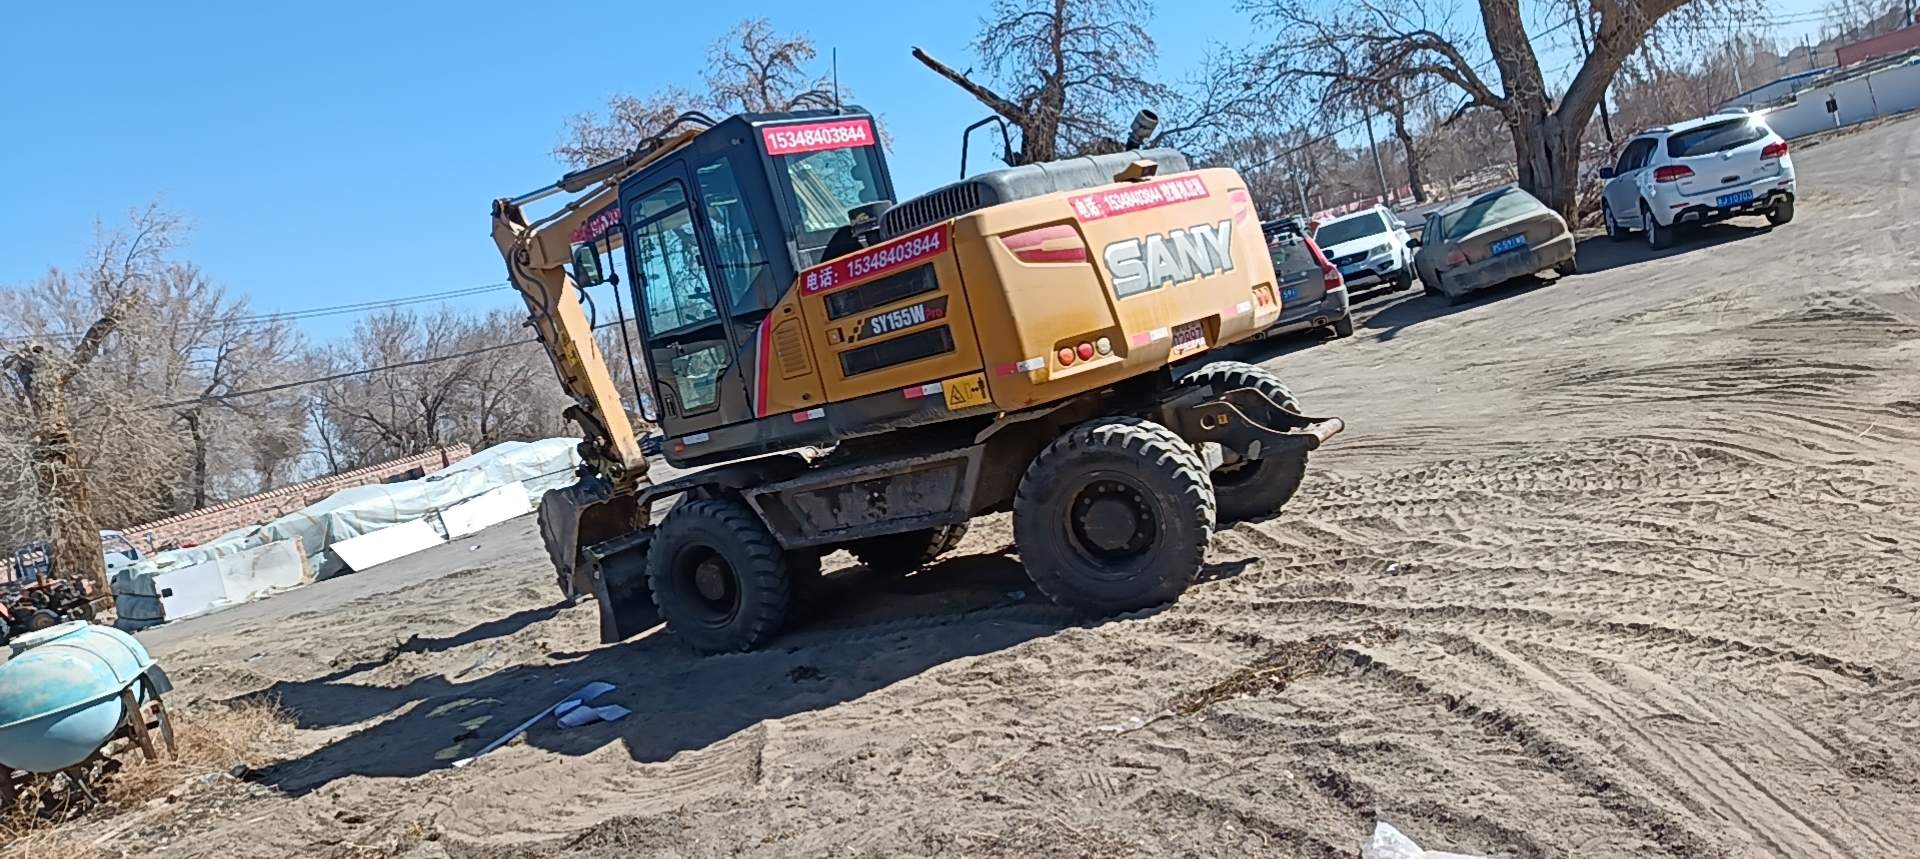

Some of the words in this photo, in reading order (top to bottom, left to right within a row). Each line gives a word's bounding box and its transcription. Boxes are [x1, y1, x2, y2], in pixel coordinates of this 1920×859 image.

[768, 126, 866, 149] 15348403844
[847, 231, 941, 278] 15348403844
[1103, 218, 1234, 301] SANY
[870, 303, 926, 335] SY155W
[925, 307, 944, 320] Pro
